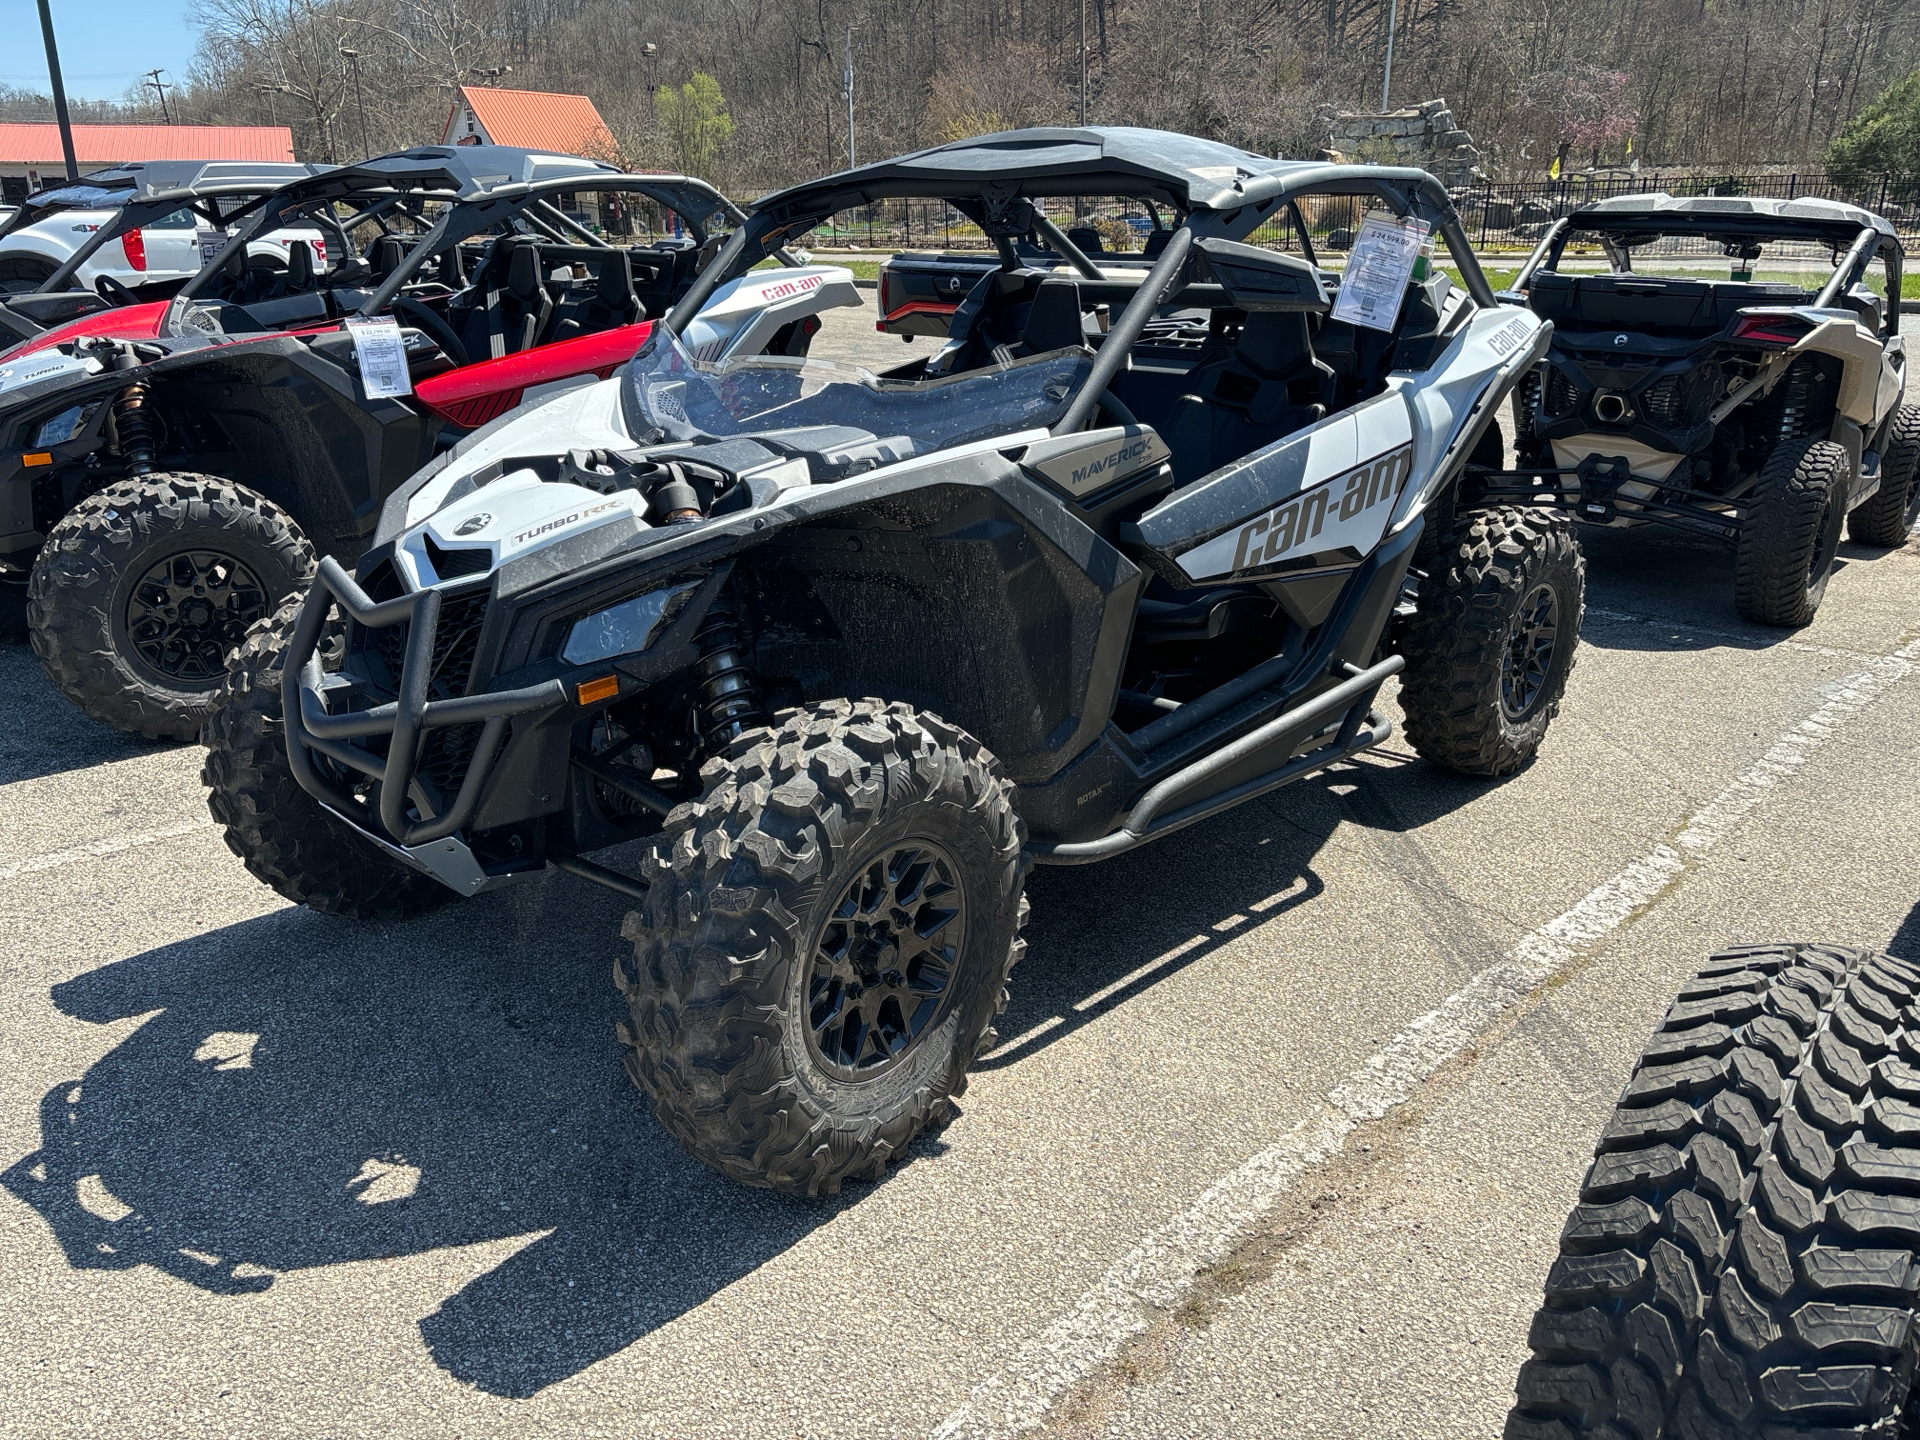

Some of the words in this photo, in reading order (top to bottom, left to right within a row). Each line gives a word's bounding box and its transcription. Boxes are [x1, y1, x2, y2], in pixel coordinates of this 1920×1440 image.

[71, 224, 100, 233] 4X
[1376, 232, 1410, 246] 24,599.00
[761, 275, 824, 301] can-am
[1486, 317, 1532, 357] can-am
[23, 365, 65, 380] TURBO
[1071, 436, 1153, 485] MAVERICK
[1138, 453, 1153, 464] DS
[1231, 448, 1412, 572] can-am
[514, 513, 579, 544] TURBO
[583, 501, 619, 518] RR
[1076, 786, 1103, 807] ROTAX
